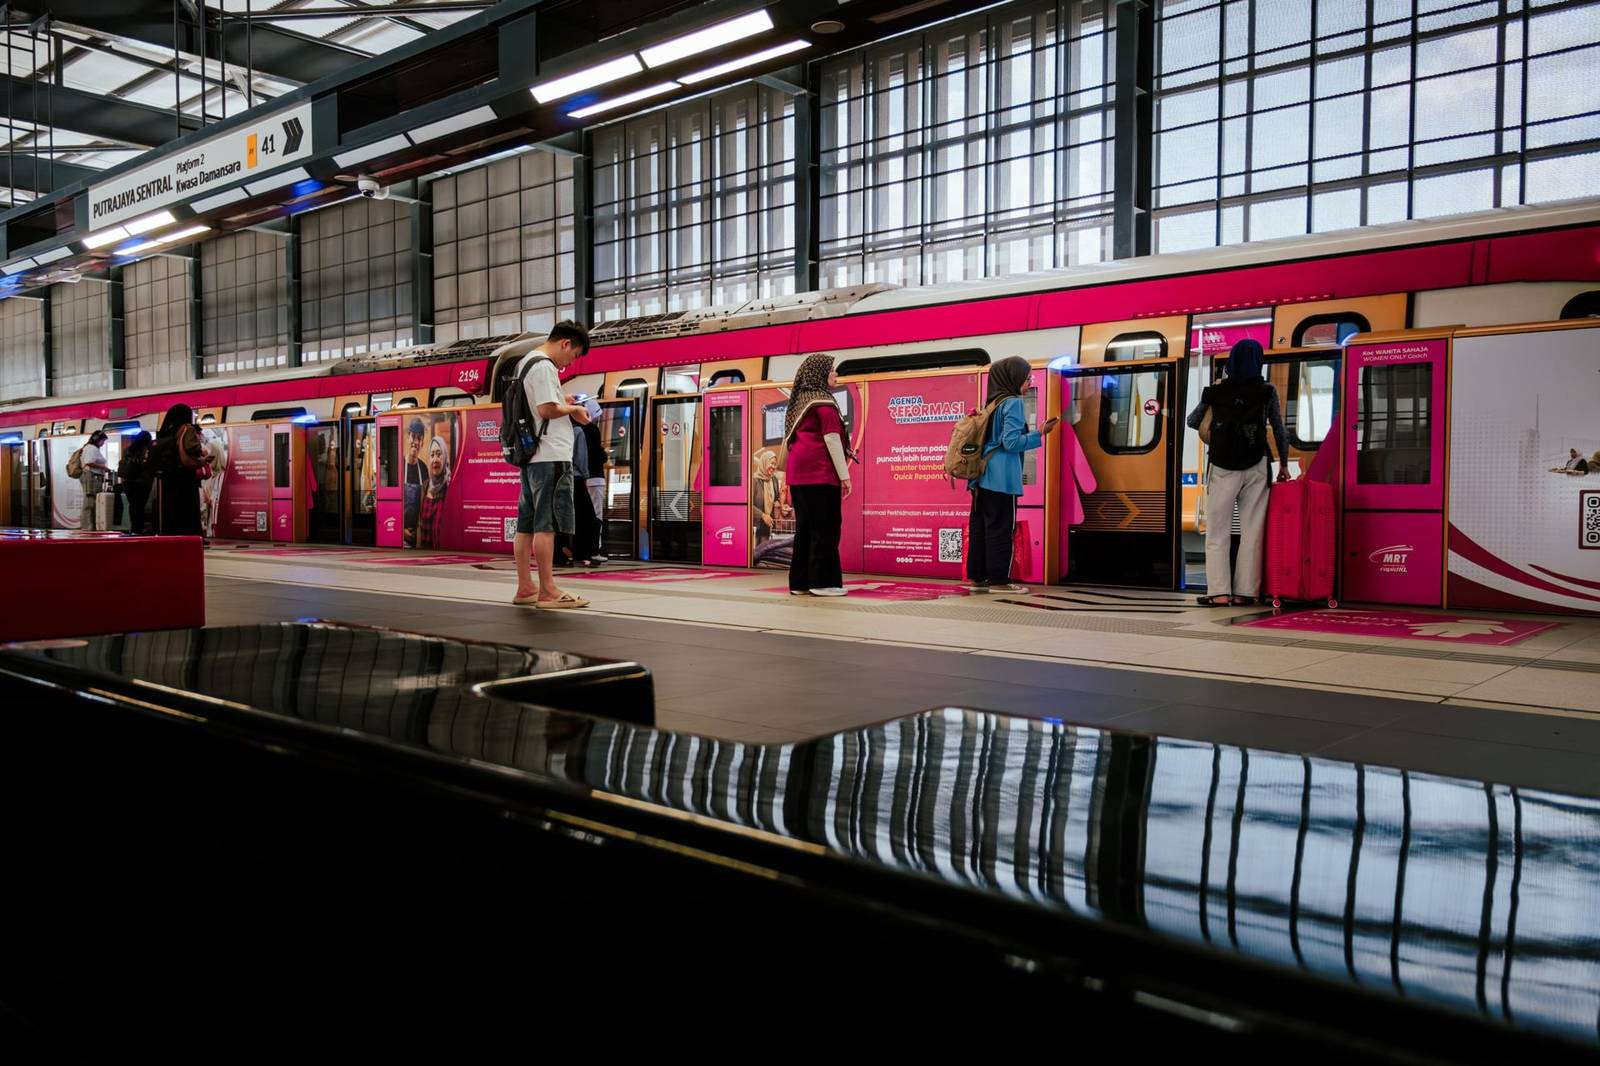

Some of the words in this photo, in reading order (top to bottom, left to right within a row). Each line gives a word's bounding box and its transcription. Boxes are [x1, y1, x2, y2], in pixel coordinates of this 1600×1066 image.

[261, 134, 276, 155] 41
[176, 157, 200, 175] Platform
[200, 153, 205, 165] 2
[176, 176, 198, 193] Kwasa
[199, 160, 241, 185] Damansara
[93, 188, 135, 218] PUTRAJAYA
[137, 175, 173, 203] SENTRAL
[458, 369, 479, 382] 2194
[890, 396, 923, 406] AGENDA
[891, 446, 928, 454] Perjalanan
[876, 456, 901, 464] puncak
[902, 454, 920, 462] lebih
[1382, 553, 1408, 563] MRT
